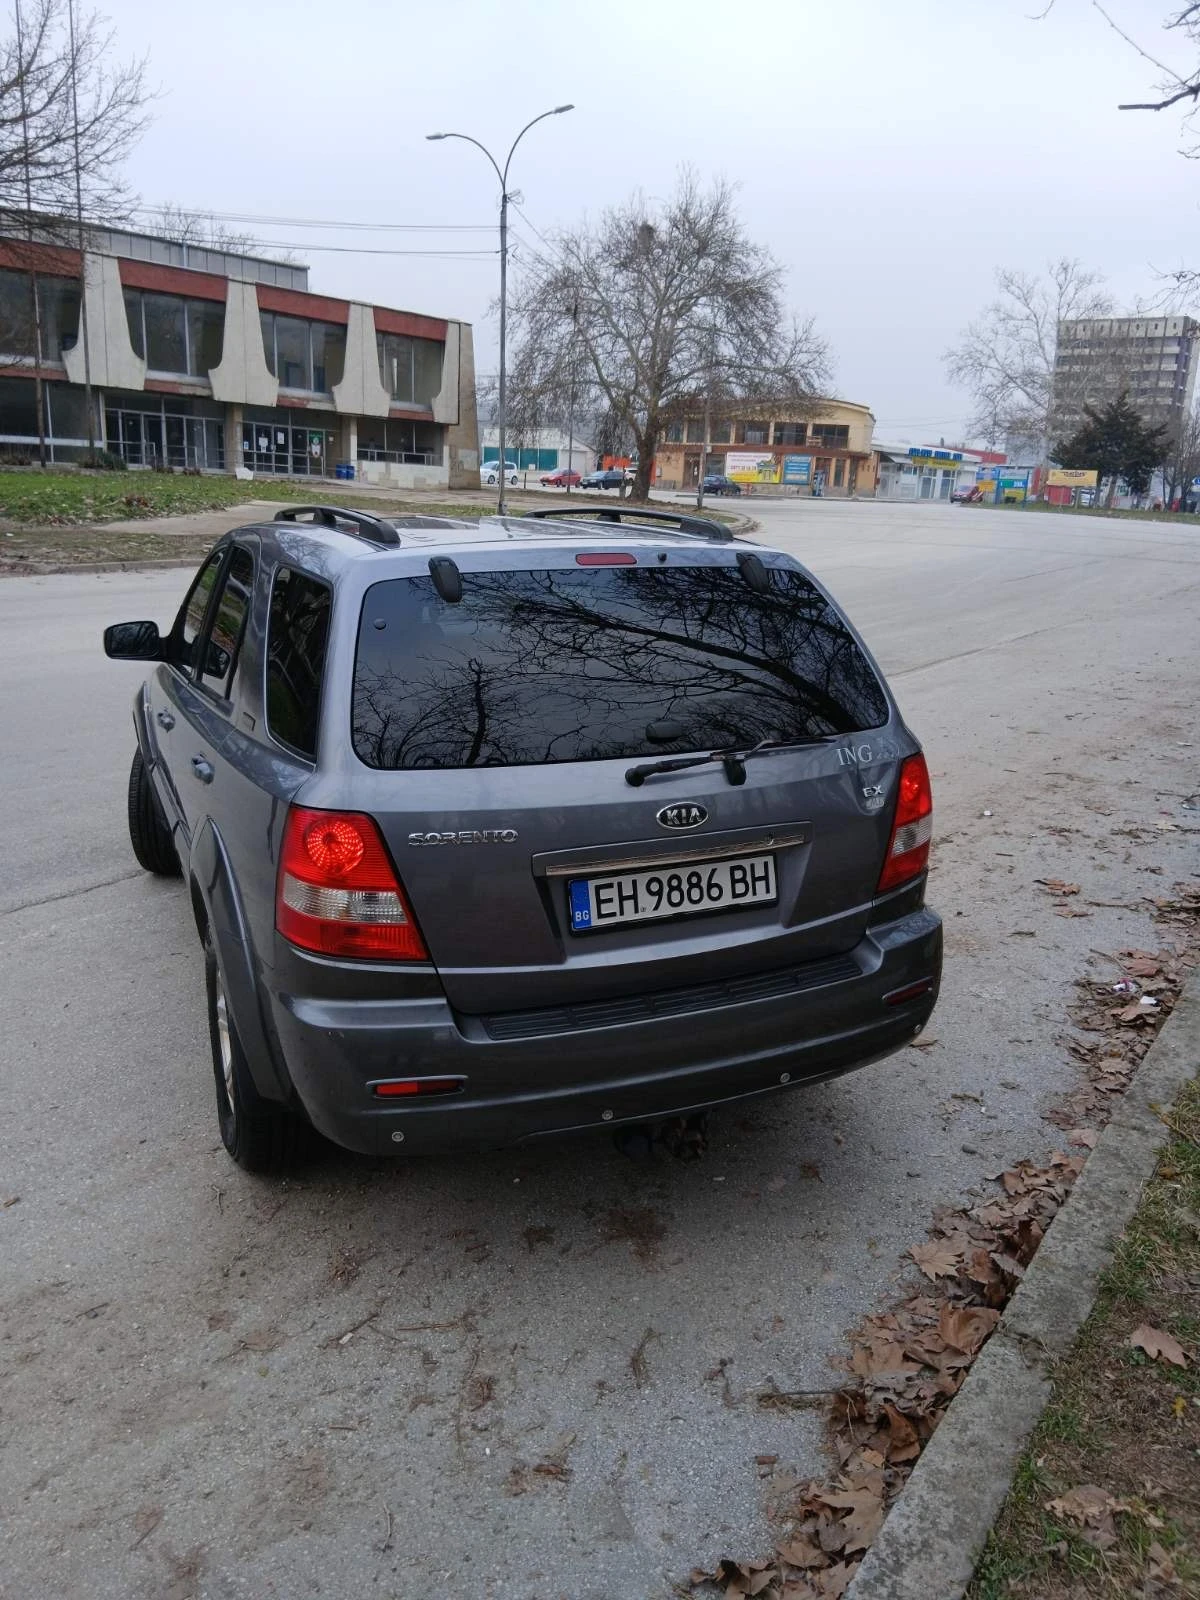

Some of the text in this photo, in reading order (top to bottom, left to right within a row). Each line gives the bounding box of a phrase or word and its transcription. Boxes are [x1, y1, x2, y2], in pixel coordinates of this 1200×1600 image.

[835, 743, 873, 766] ING
[863, 784, 884, 798] EX
[666, 807, 703, 826] KIA
[407, 829, 519, 846] SORENTO
[594, 860, 771, 920] EH 9886 BH
[575, 910, 589, 922] BG
